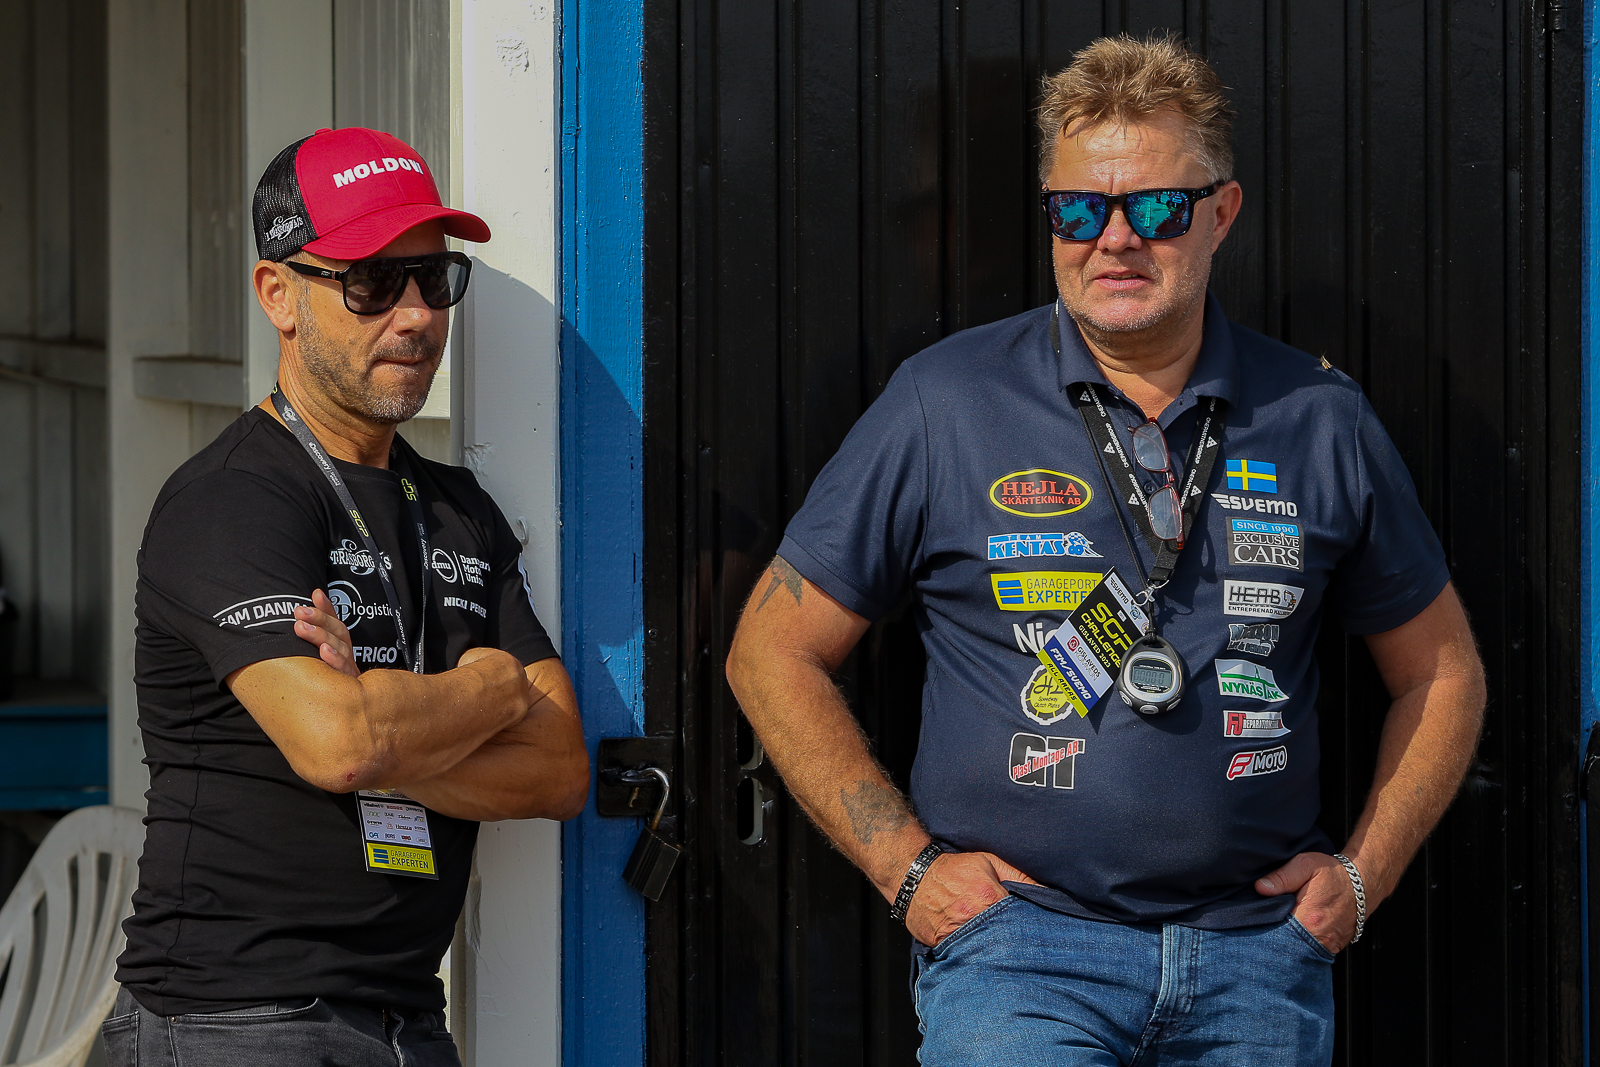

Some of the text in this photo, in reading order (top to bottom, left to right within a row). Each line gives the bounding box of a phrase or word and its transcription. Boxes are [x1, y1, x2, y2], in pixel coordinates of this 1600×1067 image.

[333, 157, 424, 188] MOLDOV
[1001, 480, 1081, 496] HEJLA
[1001, 495, 1082, 505] SKÄRTEKNIK AB
[1229, 495, 1298, 518] SVEMO
[1236, 521, 1294, 534] SINCE 1990
[988, 540, 1066, 560] KENTAS
[1233, 533, 1299, 547] EXCLUSIVE
[431, 560, 452, 570] dmu
[1234, 544, 1299, 567] CARS
[1026, 578, 1098, 590] GARAGEPORT
[444, 596, 468, 610] NICKI
[1229, 585, 1281, 605] HEAB
[1228, 605, 1274, 615] ENTREPRENAD
[1078, 624, 1101, 654] GISLAVED
[1081, 612, 1122, 668] CHALLENGE
[352, 646, 398, 664] FRIGO
[1047, 663, 1078, 701] ALL AREAS
[1050, 647, 1092, 700] FIM/SVEMO
[1010, 732, 1086, 790] GT
[1013, 740, 1079, 779] Plast Montage AB
[1254, 750, 1286, 772] MOTO
[391, 857, 429, 870] EXPERTEN
